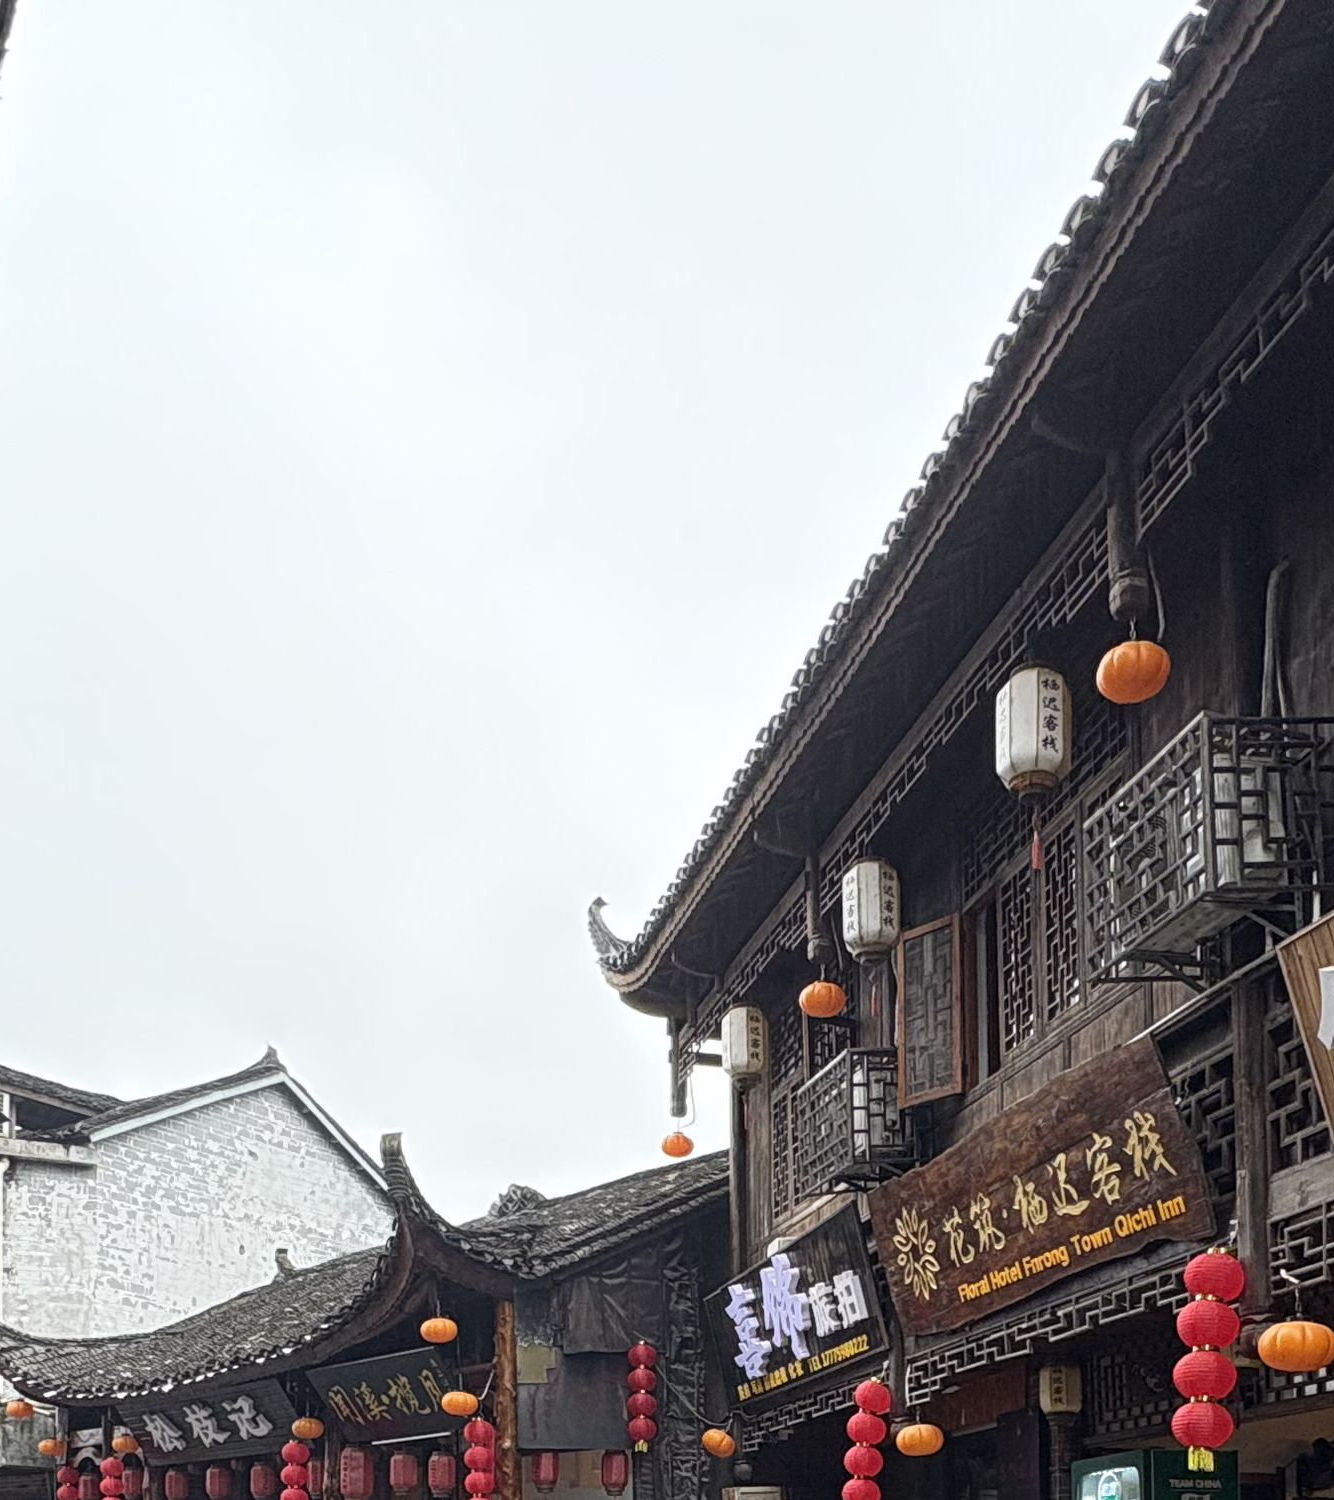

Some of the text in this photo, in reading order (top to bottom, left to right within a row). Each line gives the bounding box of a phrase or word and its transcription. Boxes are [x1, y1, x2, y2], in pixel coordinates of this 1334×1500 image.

[957, 1276, 989, 1303] Floral
[989, 1265, 1023, 1291] Hotel
[1071, 1227, 1114, 1256] Town
[1158, 1195, 1187, 1220] Inn
[143, 1395, 273, 1453] 松枝记
